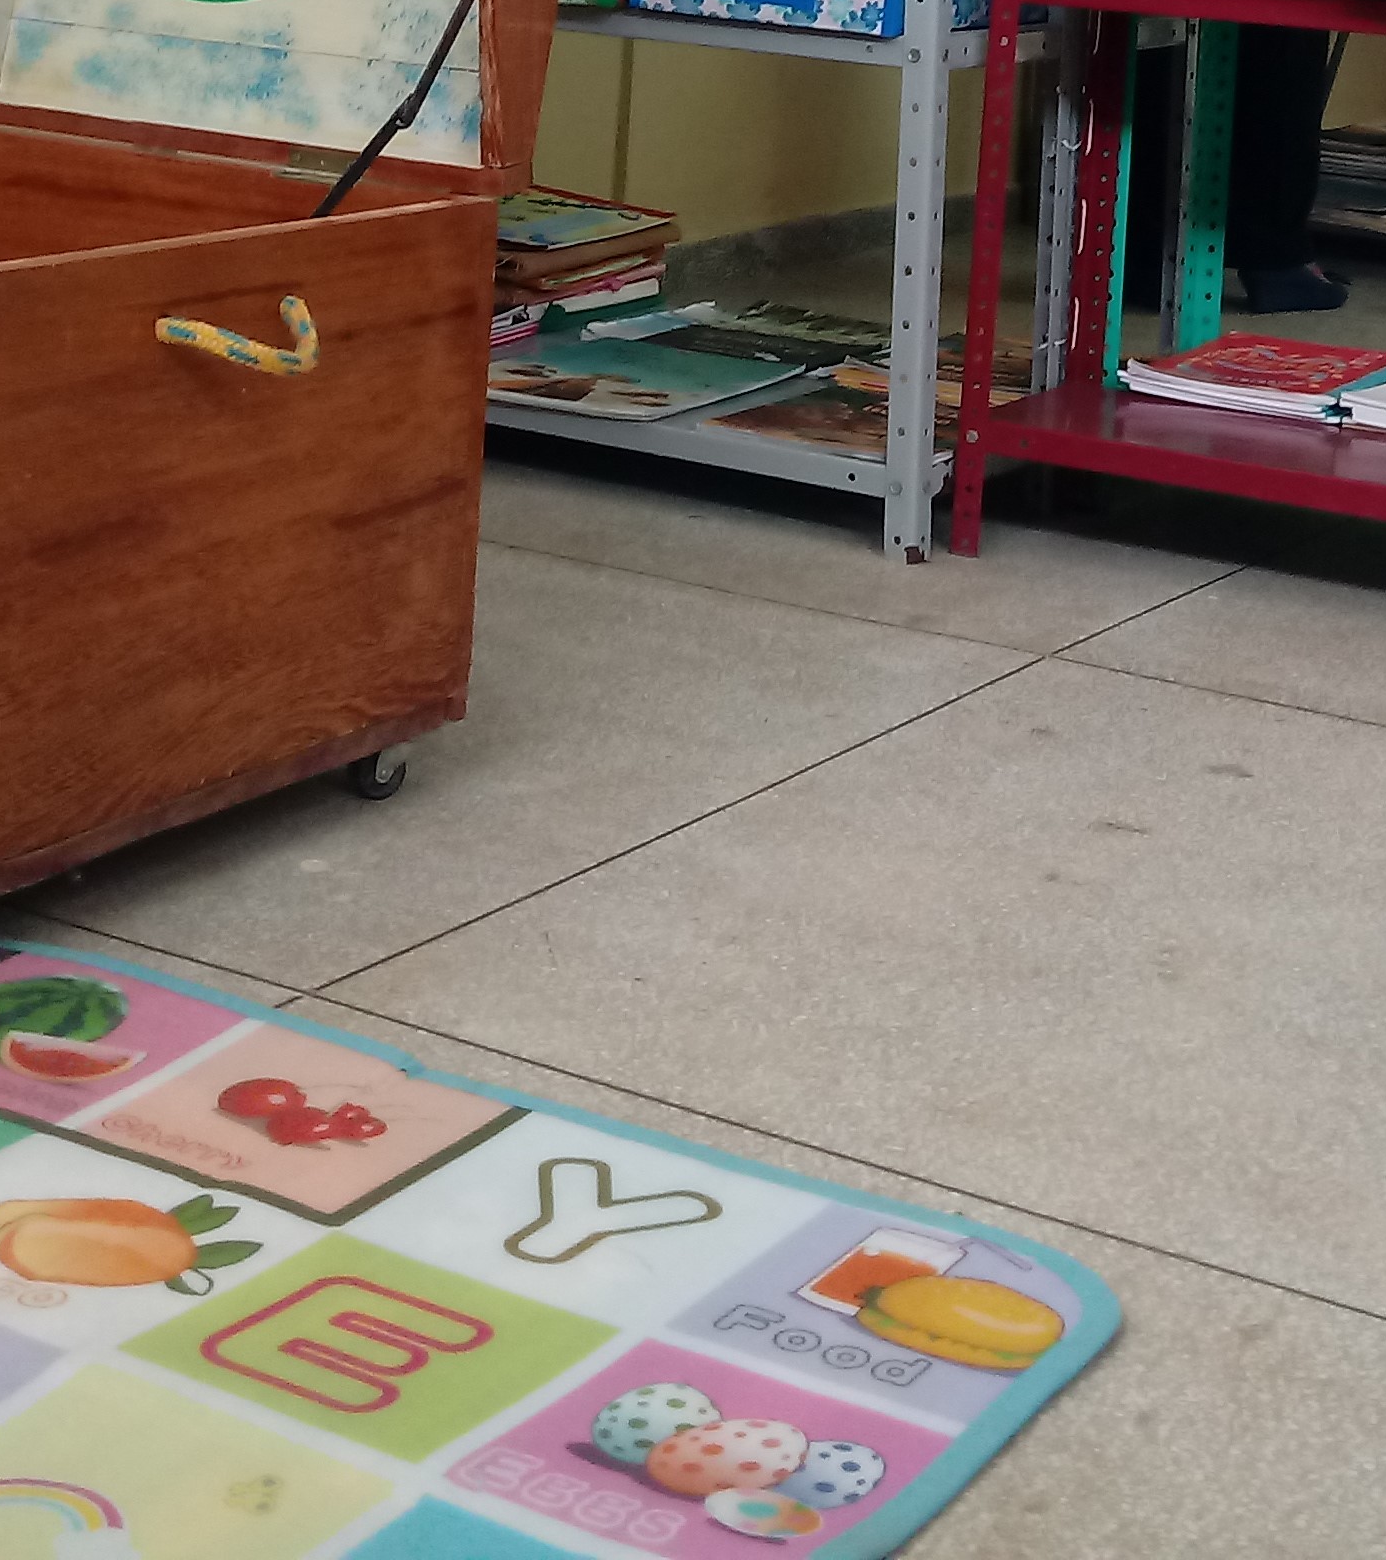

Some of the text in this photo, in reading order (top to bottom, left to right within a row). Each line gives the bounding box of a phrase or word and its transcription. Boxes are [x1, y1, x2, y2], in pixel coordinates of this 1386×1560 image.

[101, 1113, 253, 1171] Cherry
[504, 1156, 723, 1266] Y
[199, 1276, 495, 1414] E
[713, 1303, 934, 1387] Food
